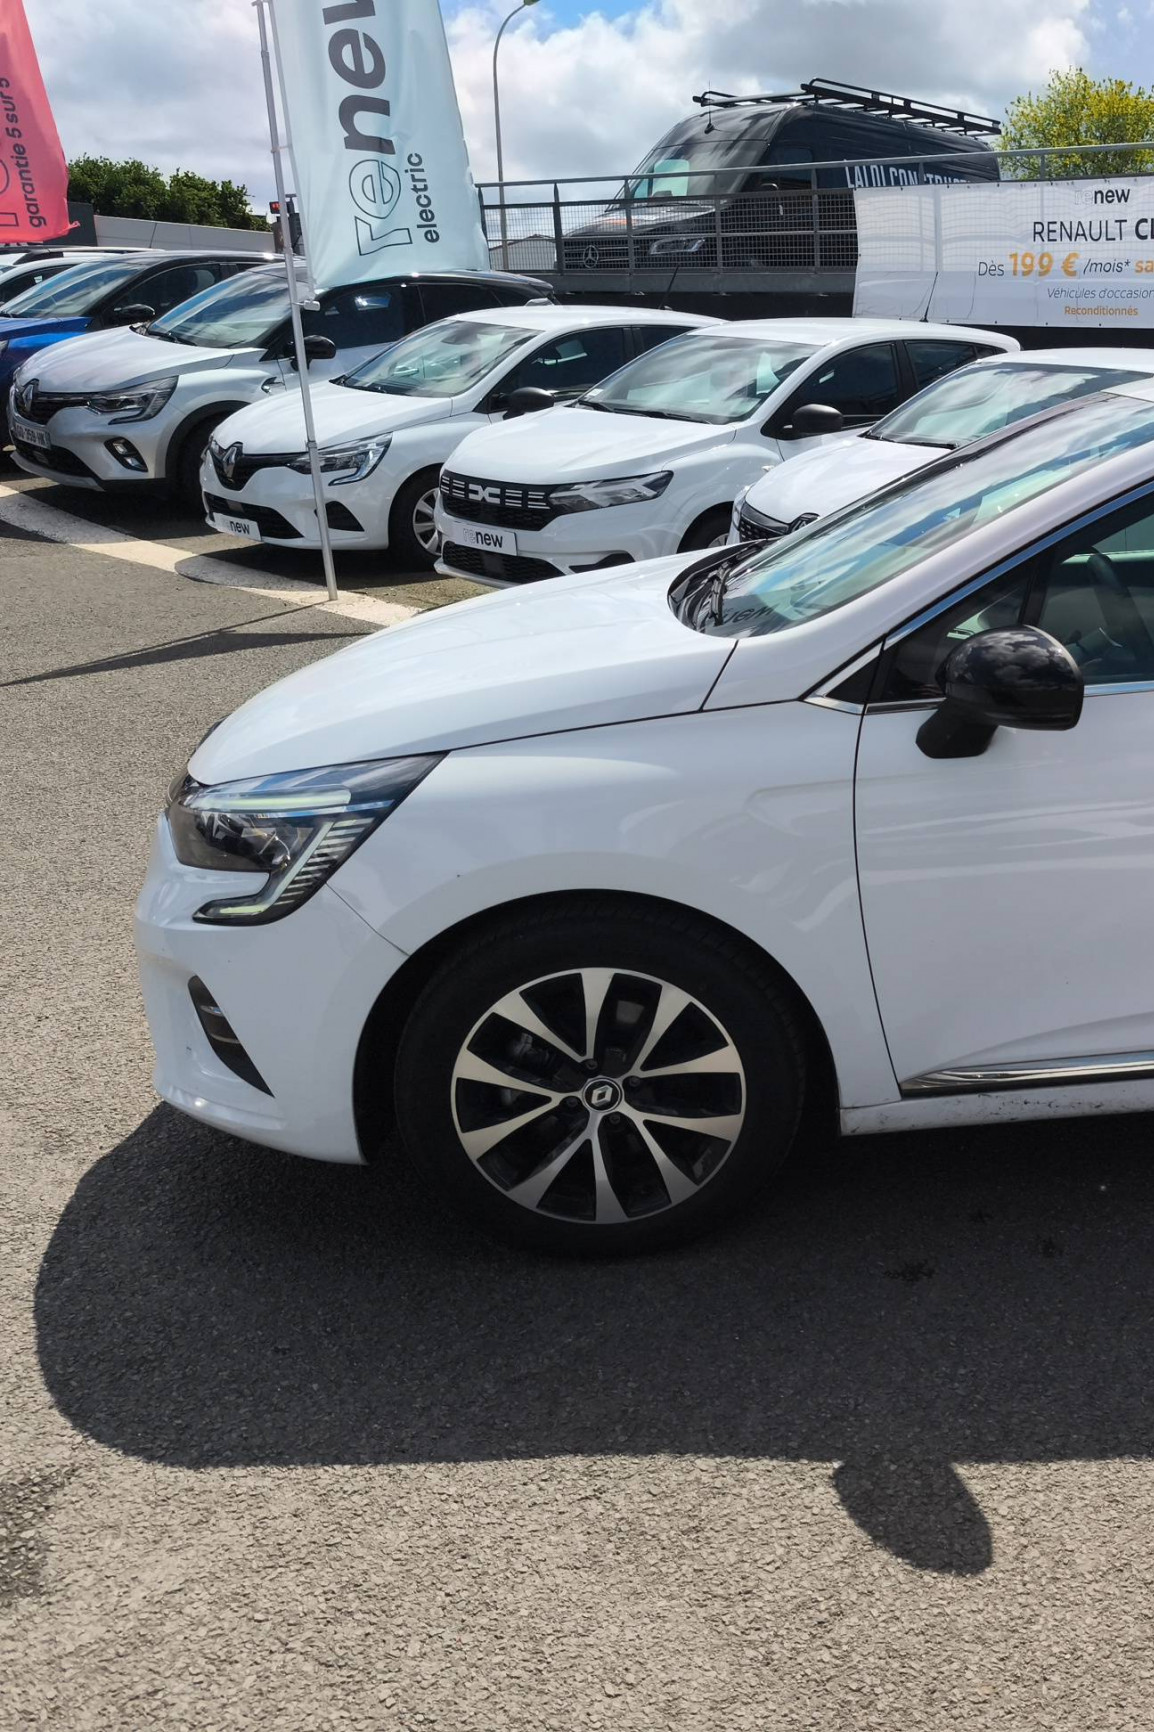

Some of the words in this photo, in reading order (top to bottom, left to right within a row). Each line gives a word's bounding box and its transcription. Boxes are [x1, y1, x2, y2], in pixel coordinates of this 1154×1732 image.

[0, 91, 19, 123] sur
[5, 127, 22, 139] 5
[10, 143, 47, 228] garantie
[404, 152, 440, 243] electric
[1033, 219, 1127, 243] RENAULT
[978, 261, 1005, 276] Dès
[1009, 252, 1053, 277] 199
[1061, 252, 1080, 277] €
[1047, 287, 1096, 299] Véhicules
[1064, 305, 1139, 317] Reconditionnés
